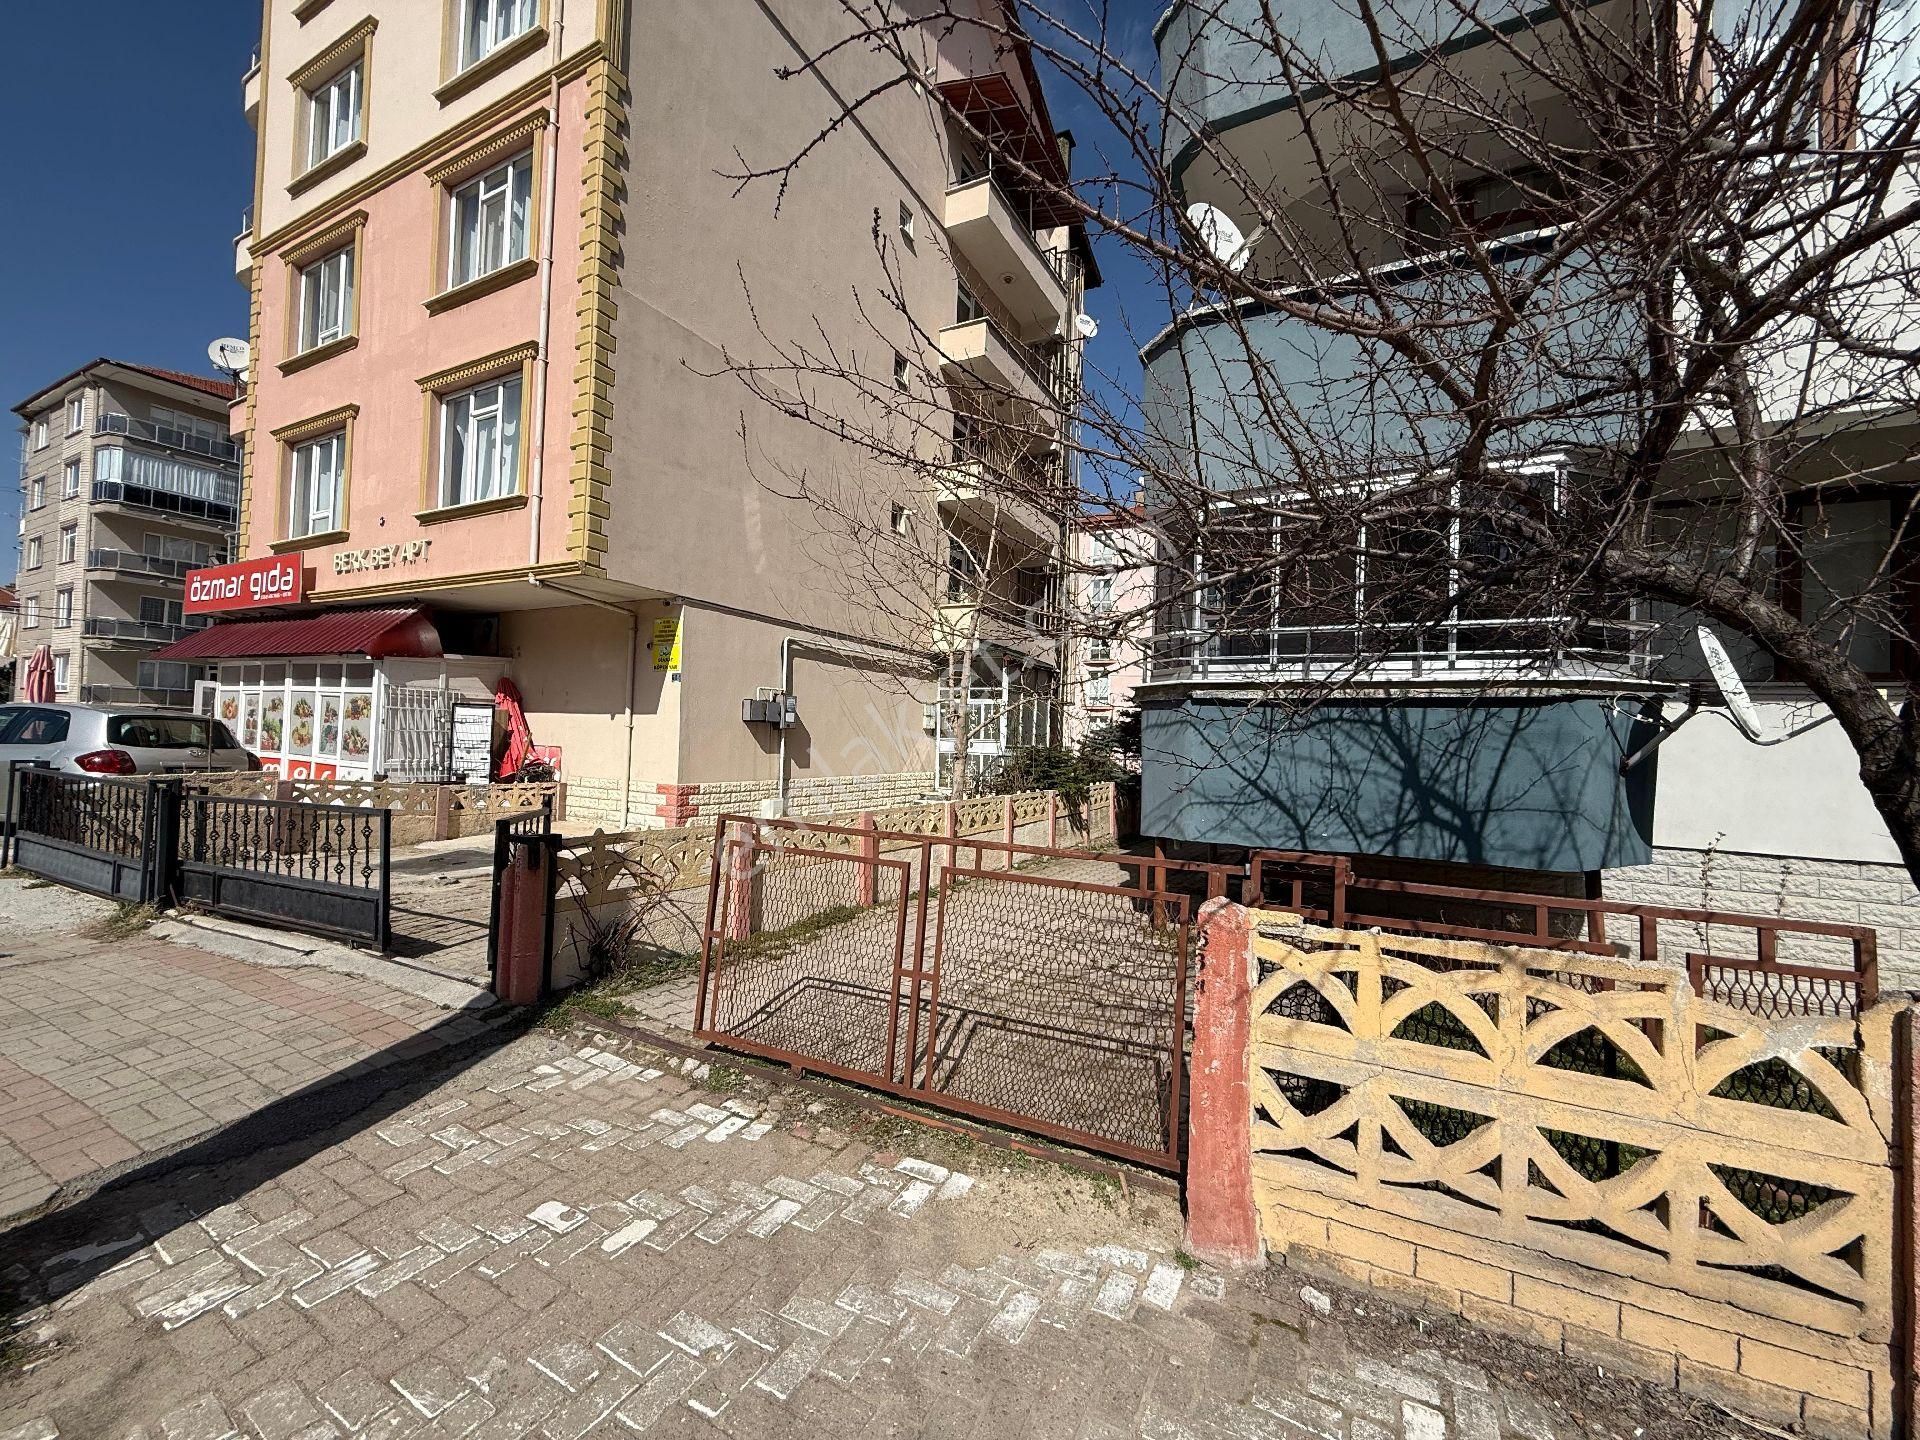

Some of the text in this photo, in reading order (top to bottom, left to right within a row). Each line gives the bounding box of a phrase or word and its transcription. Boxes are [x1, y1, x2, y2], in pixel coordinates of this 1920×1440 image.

[333, 540, 432, 572] BERK BEY APT
[190, 562, 294, 602] özmar gıda
